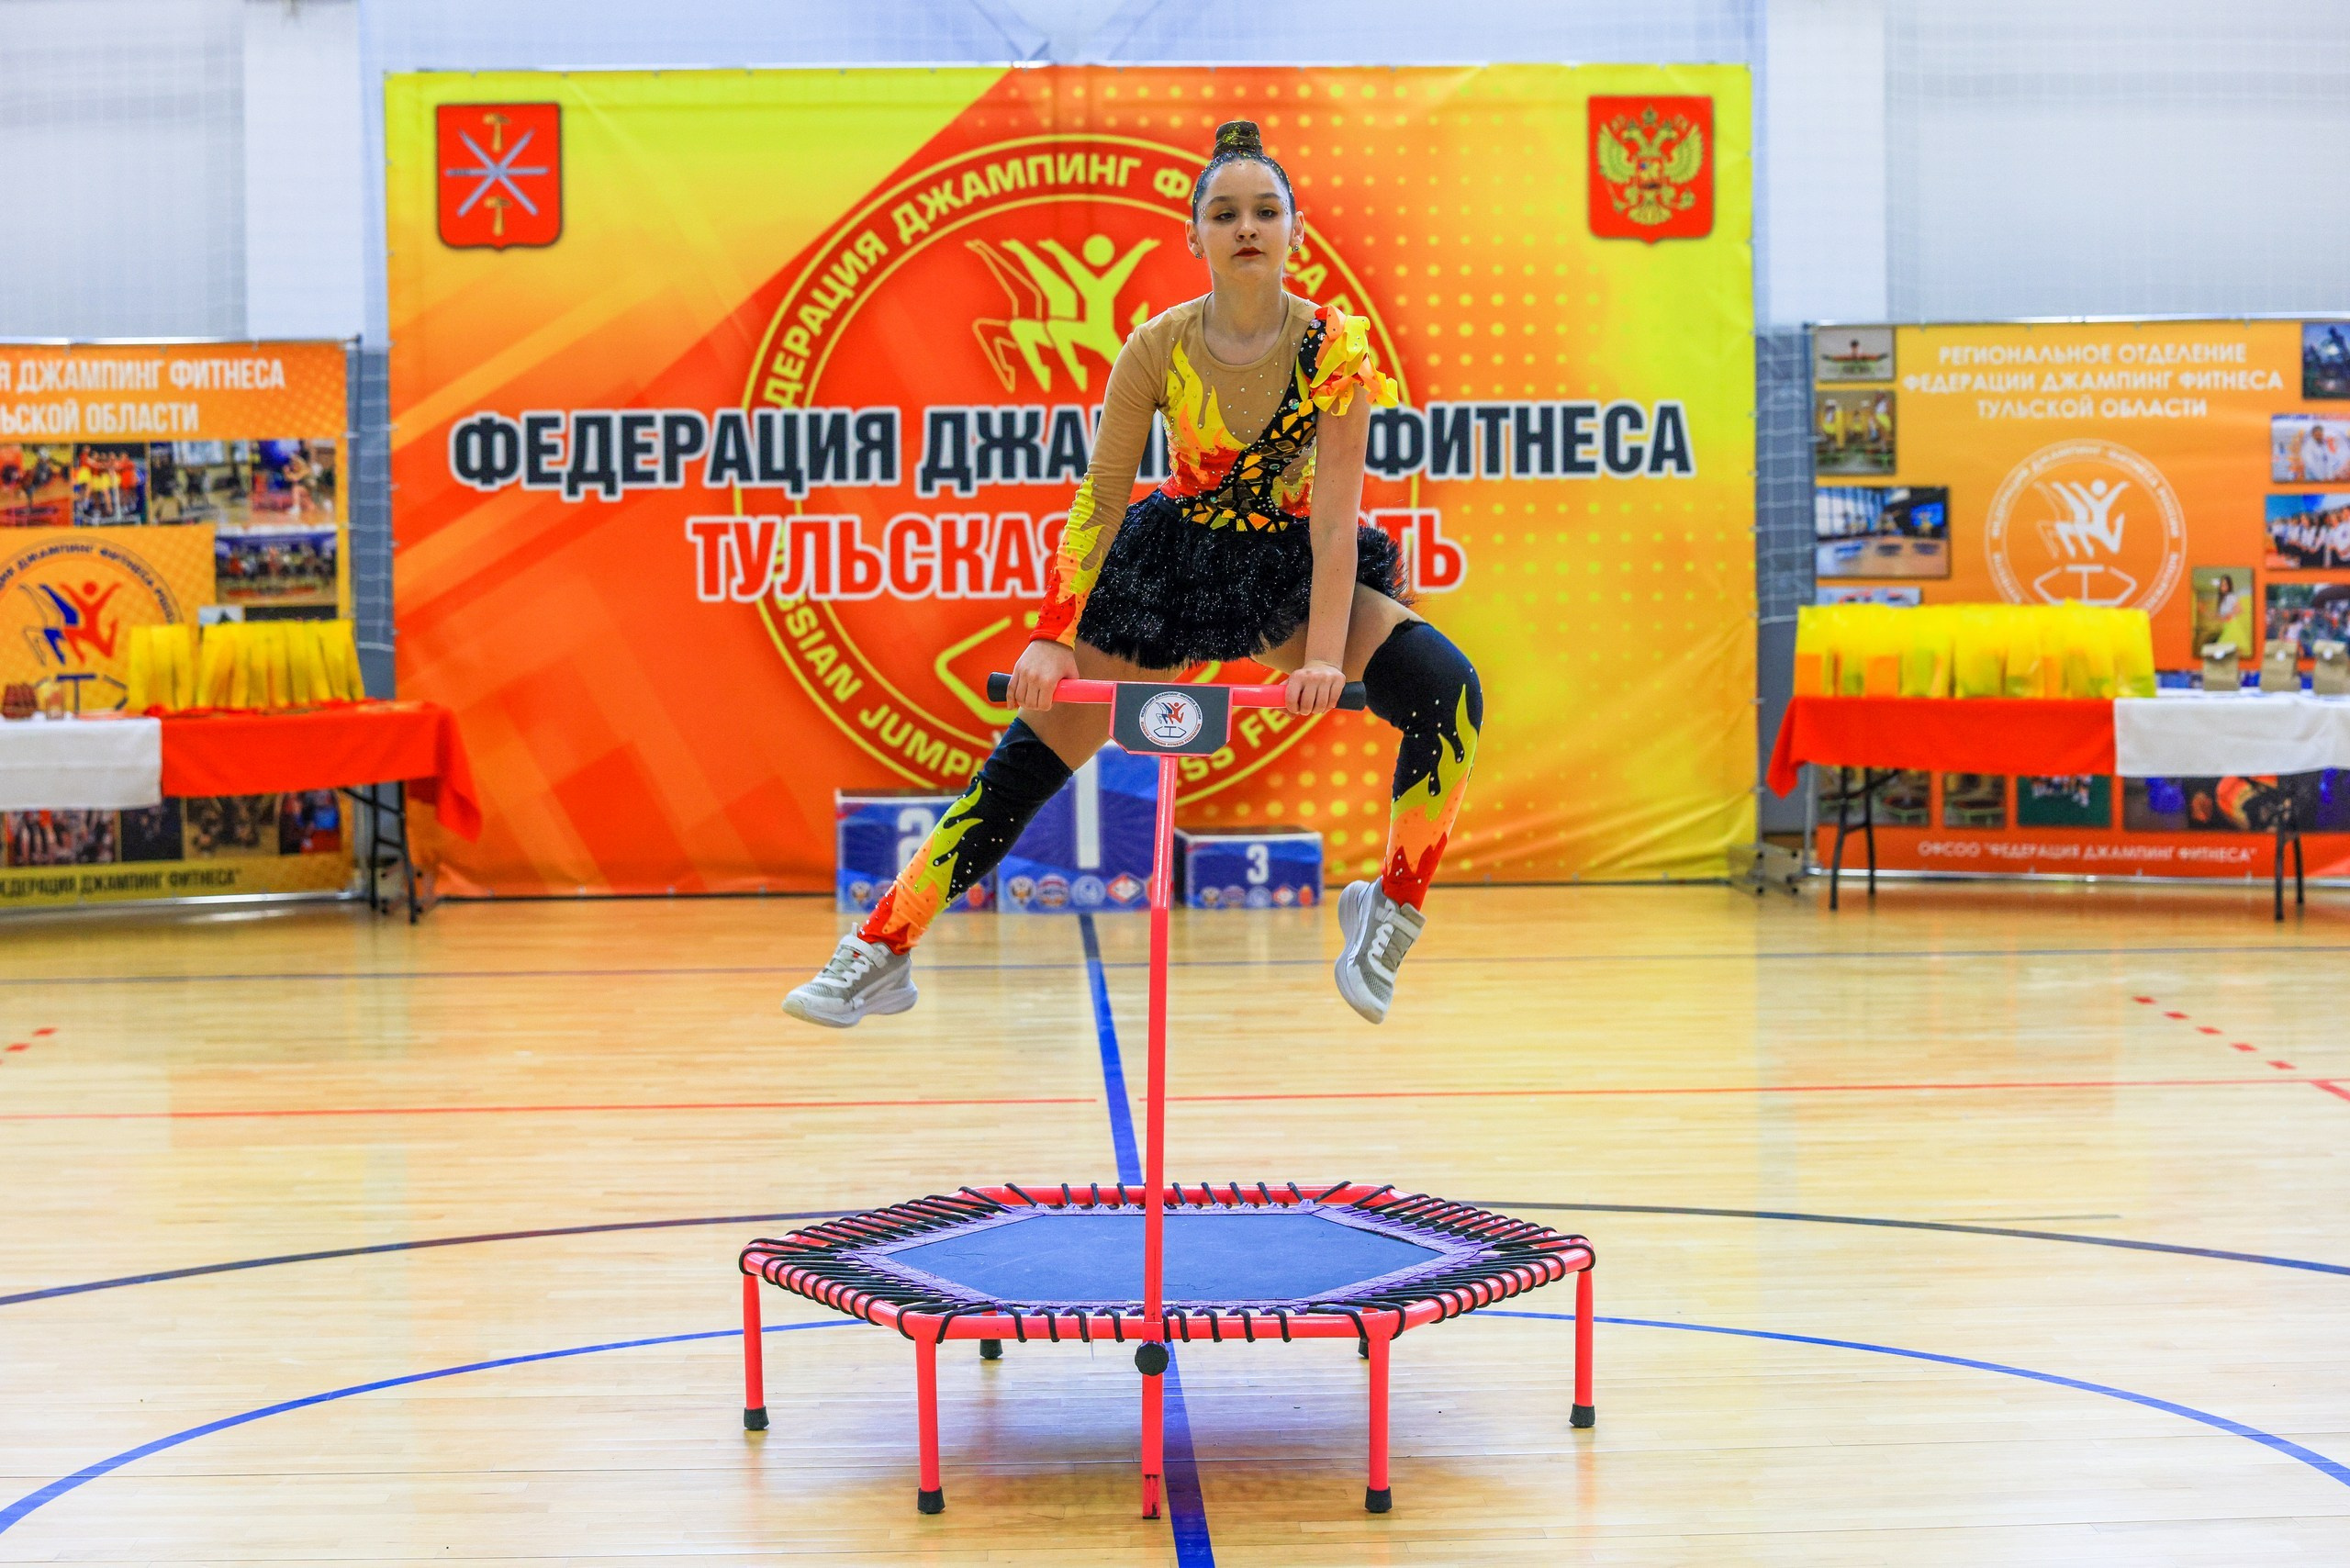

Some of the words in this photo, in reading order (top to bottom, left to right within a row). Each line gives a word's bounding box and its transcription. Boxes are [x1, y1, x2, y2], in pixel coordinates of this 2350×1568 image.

[891, 152, 1142, 240] ДЖАМПИНГ
[763, 230, 888, 409] ДЕРАЦИЯ
[1939, 344, 2110, 366] РЕГИОНАЛЬНОЕ
[2121, 343, 2247, 364] ОТДЕЛЕНИЕ
[17, 359, 164, 394] ДЖАМПИНГ
[169, 358, 285, 390] ФИТНЕСА
[1903, 372, 2036, 394] ФЕДЕРАЦИИ
[2040, 371, 2171, 393] ДЖАМПИНГ
[2177, 370, 2284, 391] ФИТНЕСА
[86, 401, 200, 433] ОБЛАСТИ
[1977, 394, 2095, 420] ТУЛЬСКОЙ
[2100, 398, 2208, 419] ОБЛАСТИ
[453, 410, 897, 498] ФЕДЕРАЦИЯ
[1365, 404, 1694, 477] ФИТНЕСА
[858, 703, 984, 789] JUMPI
[1246, 844, 1270, 885] 3
